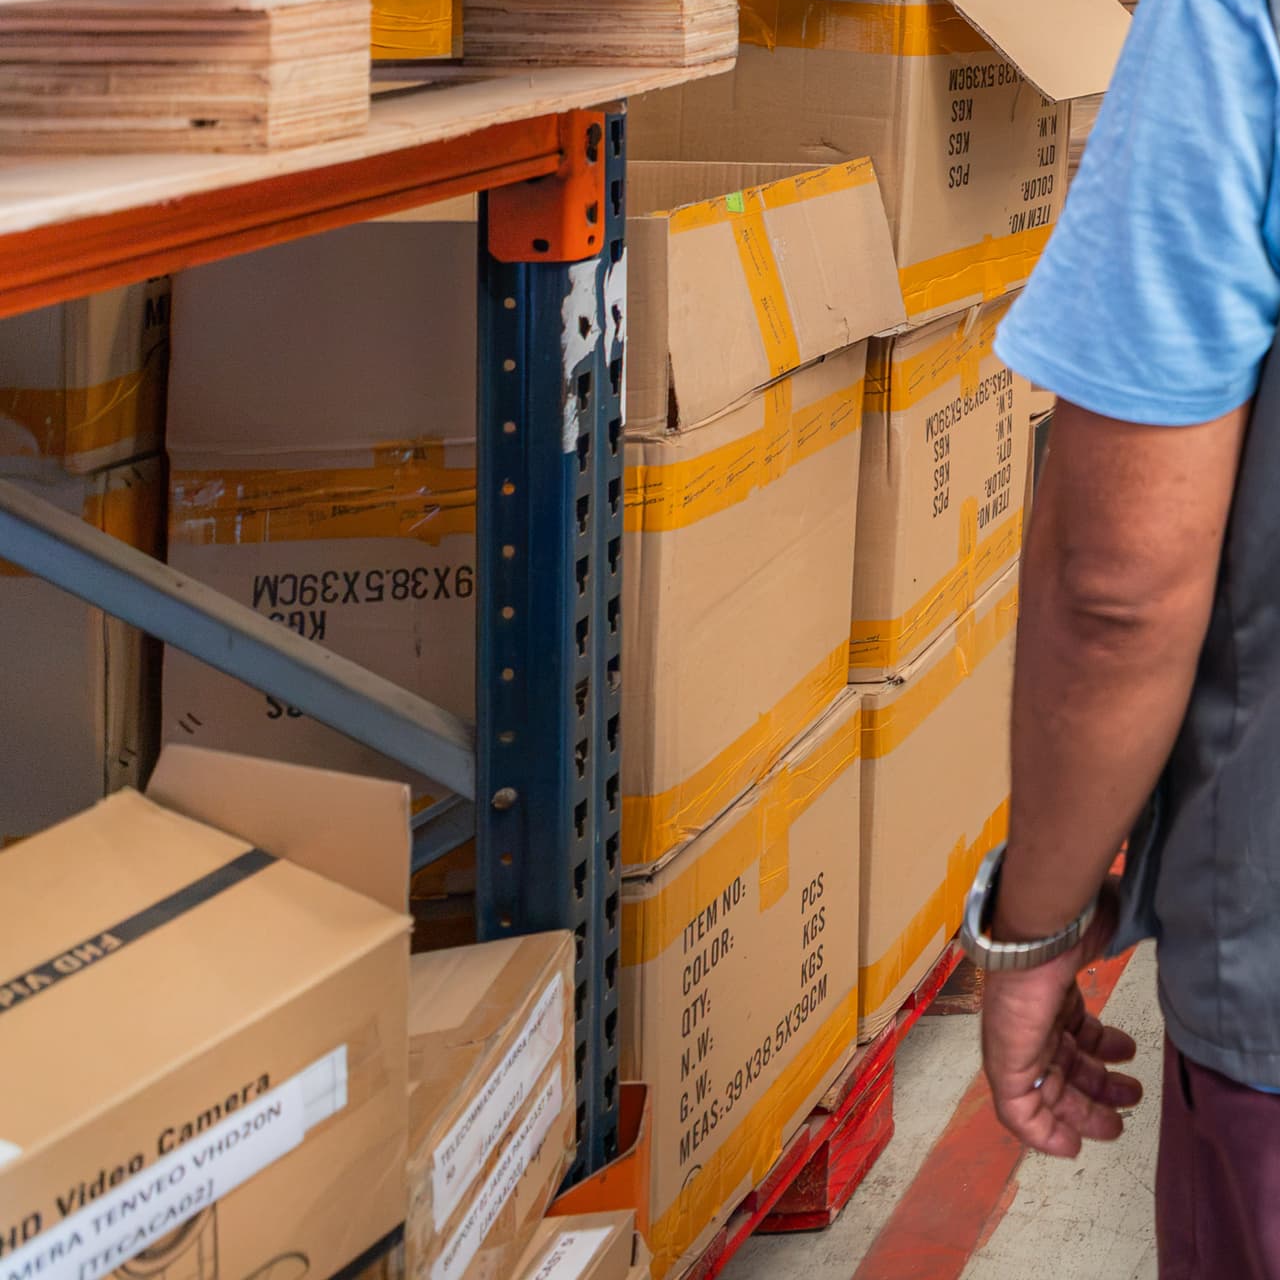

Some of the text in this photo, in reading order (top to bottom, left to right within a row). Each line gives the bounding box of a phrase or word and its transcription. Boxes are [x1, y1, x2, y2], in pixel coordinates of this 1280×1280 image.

[951, 98, 973, 123] KGS
[948, 131, 970, 156] KGS
[1037, 145, 1056, 168] QTY:
[948, 163, 970, 189] PCS
[1021, 174, 1053, 202] COLOR:
[1009, 204, 1052, 235] ITEM NO:
[933, 433, 950, 463] KGS
[933, 461, 950, 492] KGS
[984, 463, 1012, 498] COLOR:
[933, 486, 949, 518] PCS
[992, 488, 1010, 518] ITEM
[801, 871, 824, 915] PCS
[683, 876, 746, 955] ITEM NO:
[802, 906, 826, 950] KGS
[682, 927, 735, 997] COLOR:
[801, 944, 824, 988] KGS
[681, 988, 712, 1039] QTY:
[680, 1027, 714, 1083] N.W:
[680, 1069, 713, 1124] G.W:
[55, 1071, 270, 1218] Video Camera
[91, 1100, 283, 1236] TENVEO VHD20N
